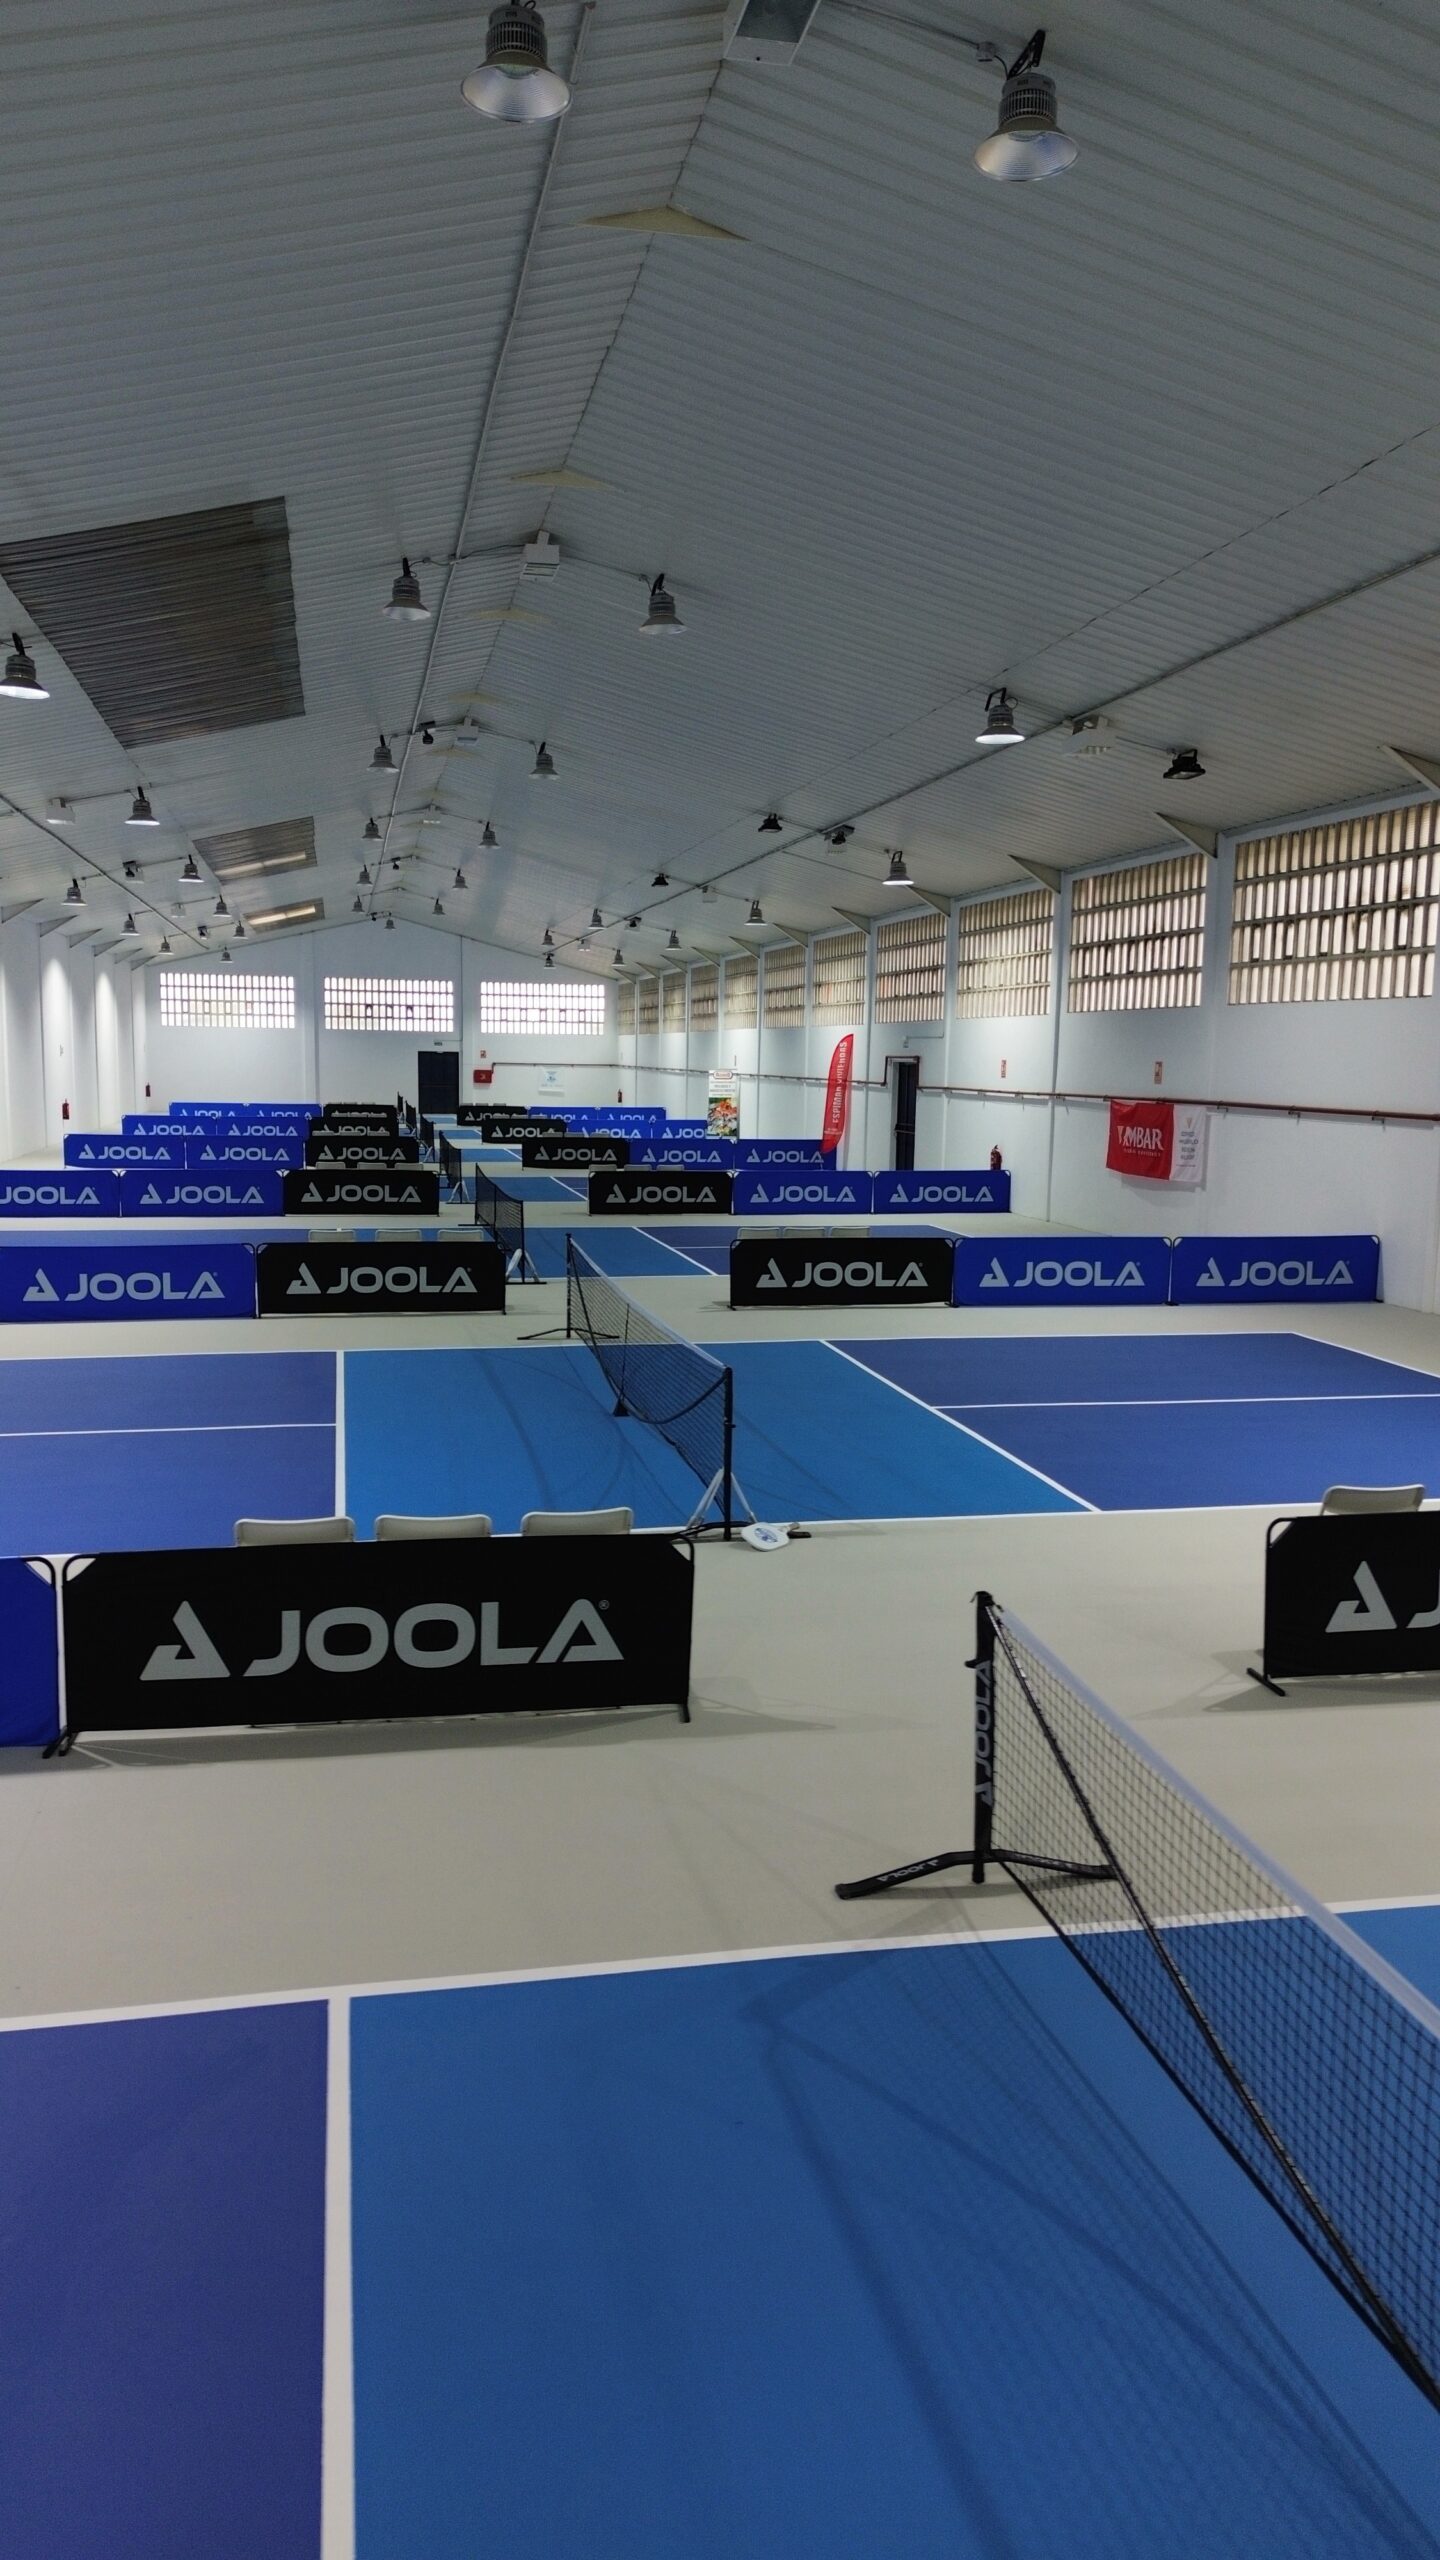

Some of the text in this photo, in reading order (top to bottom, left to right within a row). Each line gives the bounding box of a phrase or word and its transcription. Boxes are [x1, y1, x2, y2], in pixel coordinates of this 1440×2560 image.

[145, 1125, 206, 1136] JOOLA
[242, 1125, 298, 1136] JOOLA
[675, 1128, 705, 1138] JOO
[97, 1146, 171, 1160] JOOLA
[218, 1148, 290, 1161] JOOLA
[336, 1147, 406, 1161] JOOLA
[551, 1148, 618, 1161] JOOLA
[658, 1150, 722, 1163] JOOLA
[762, 1150, 825, 1163] JOOLA
[0, 1186, 100, 1204] JOOLA
[165, 1186, 265, 1204] JOOLA
[326, 1185, 422, 1203] JOOLA
[628, 1186, 717, 1203] JOOLA
[772, 1186, 856, 1203] JOOLA
[911, 1186, 994, 1203] JOOLA
[326, 1266, 478, 1294] JOOLA
[791, 1262, 929, 1288] JOOLA
[1013, 1261, 1145, 1287] JOOLA
[1228, 1260, 1354, 1287] JOOLA
[65, 1272, 225, 1301] JOOLA
[242, 1598, 625, 1677] JOOLA
[975, 1660, 991, 1778] JOOLA
[877, 1862, 927, 1882] JOOLA
